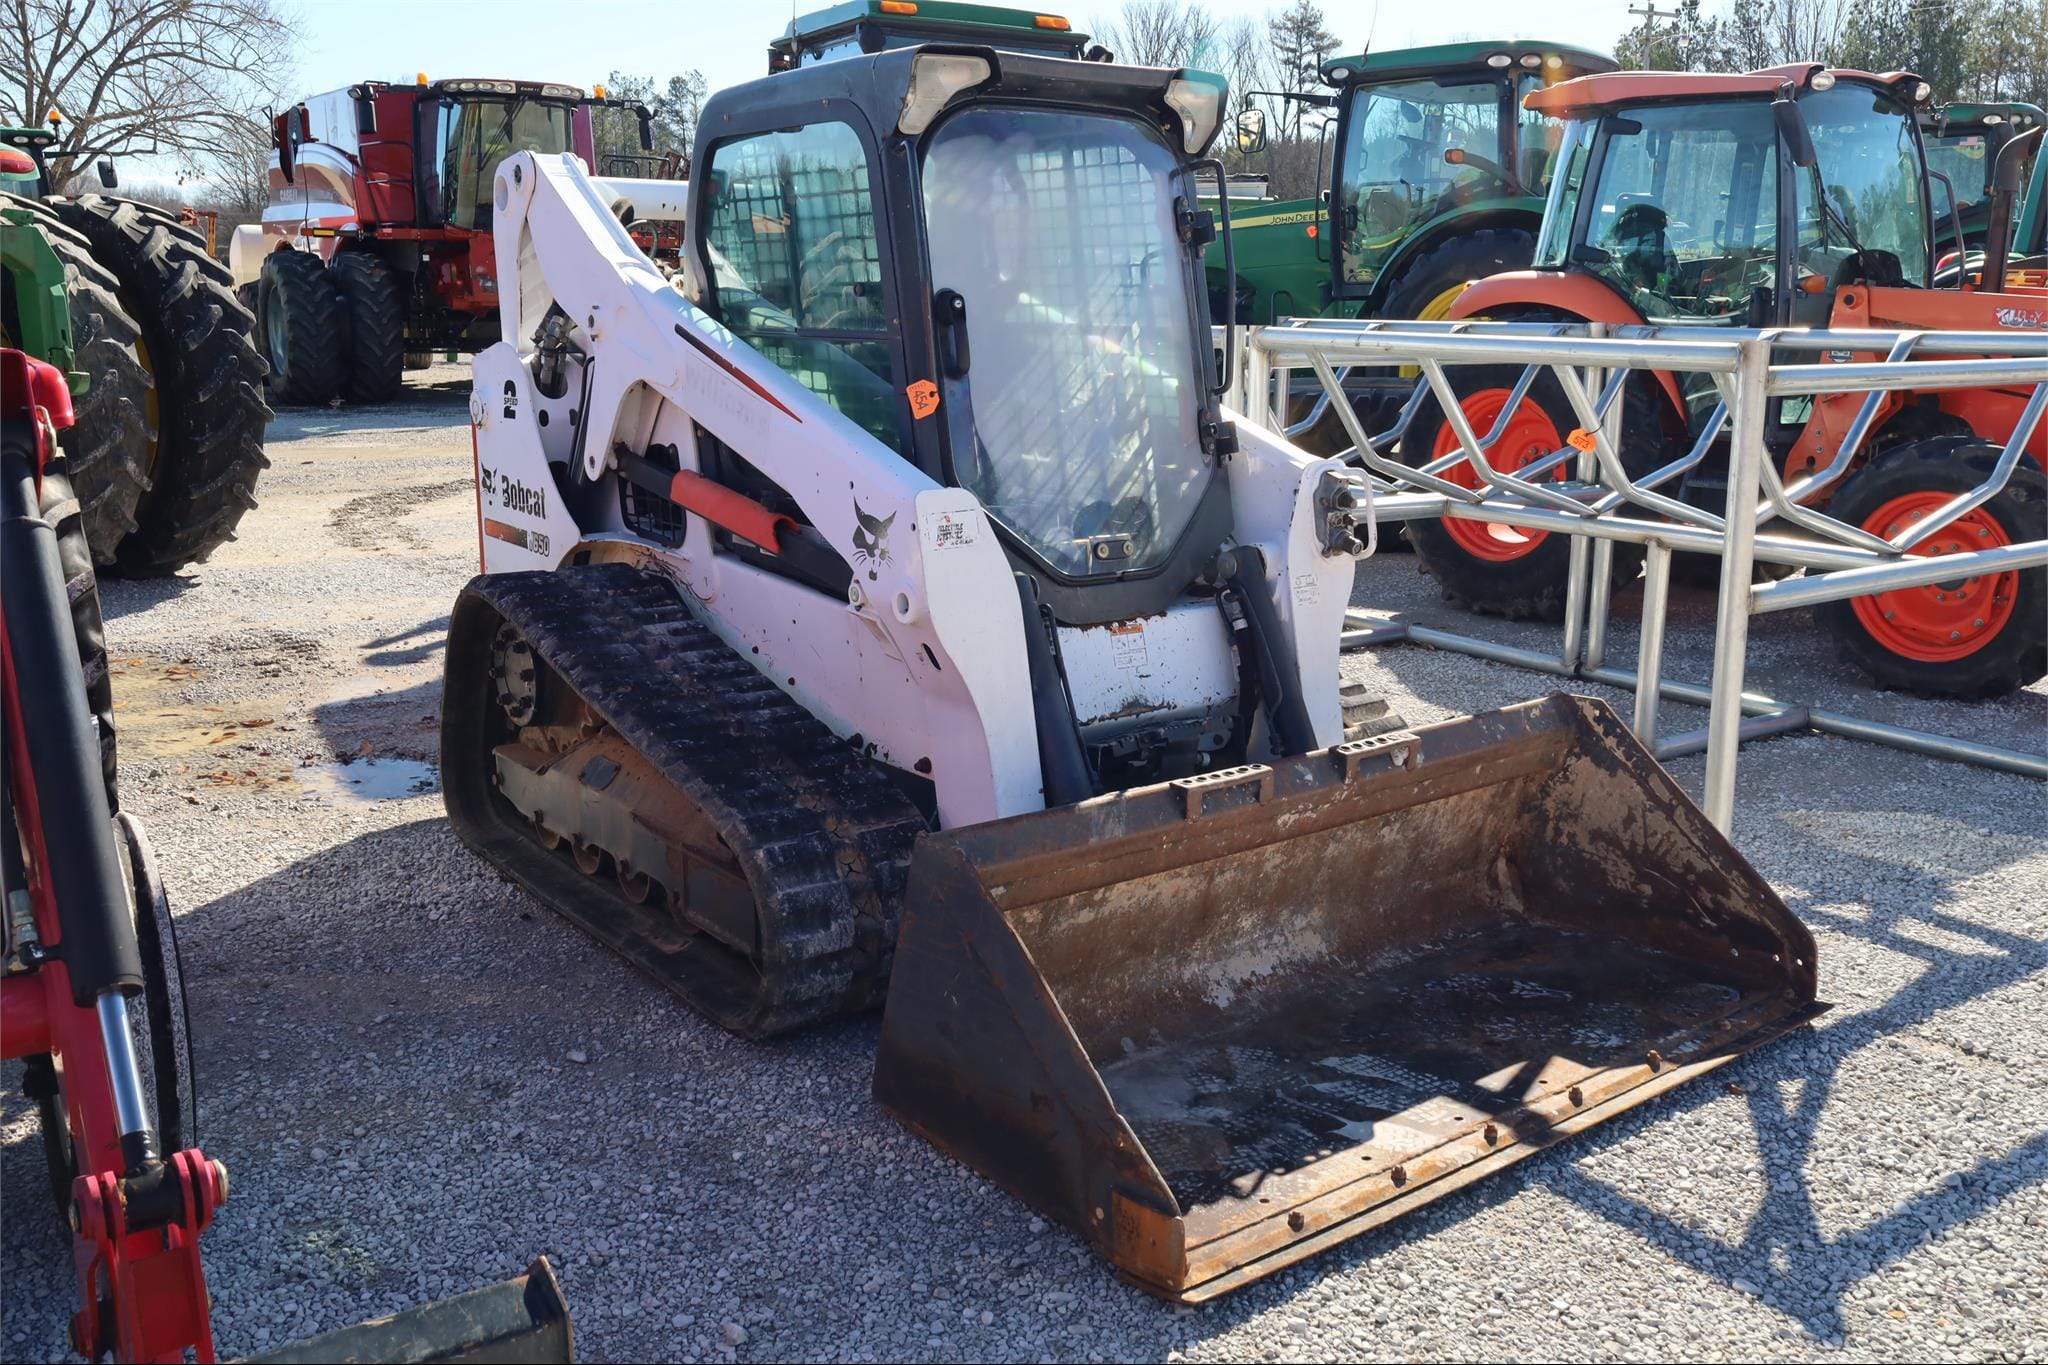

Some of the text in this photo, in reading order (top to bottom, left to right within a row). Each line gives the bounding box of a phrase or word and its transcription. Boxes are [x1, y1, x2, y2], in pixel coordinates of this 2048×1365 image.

[1271, 211, 1327, 225] JOHN DEEE
[501, 474, 546, 520] Bobcat
